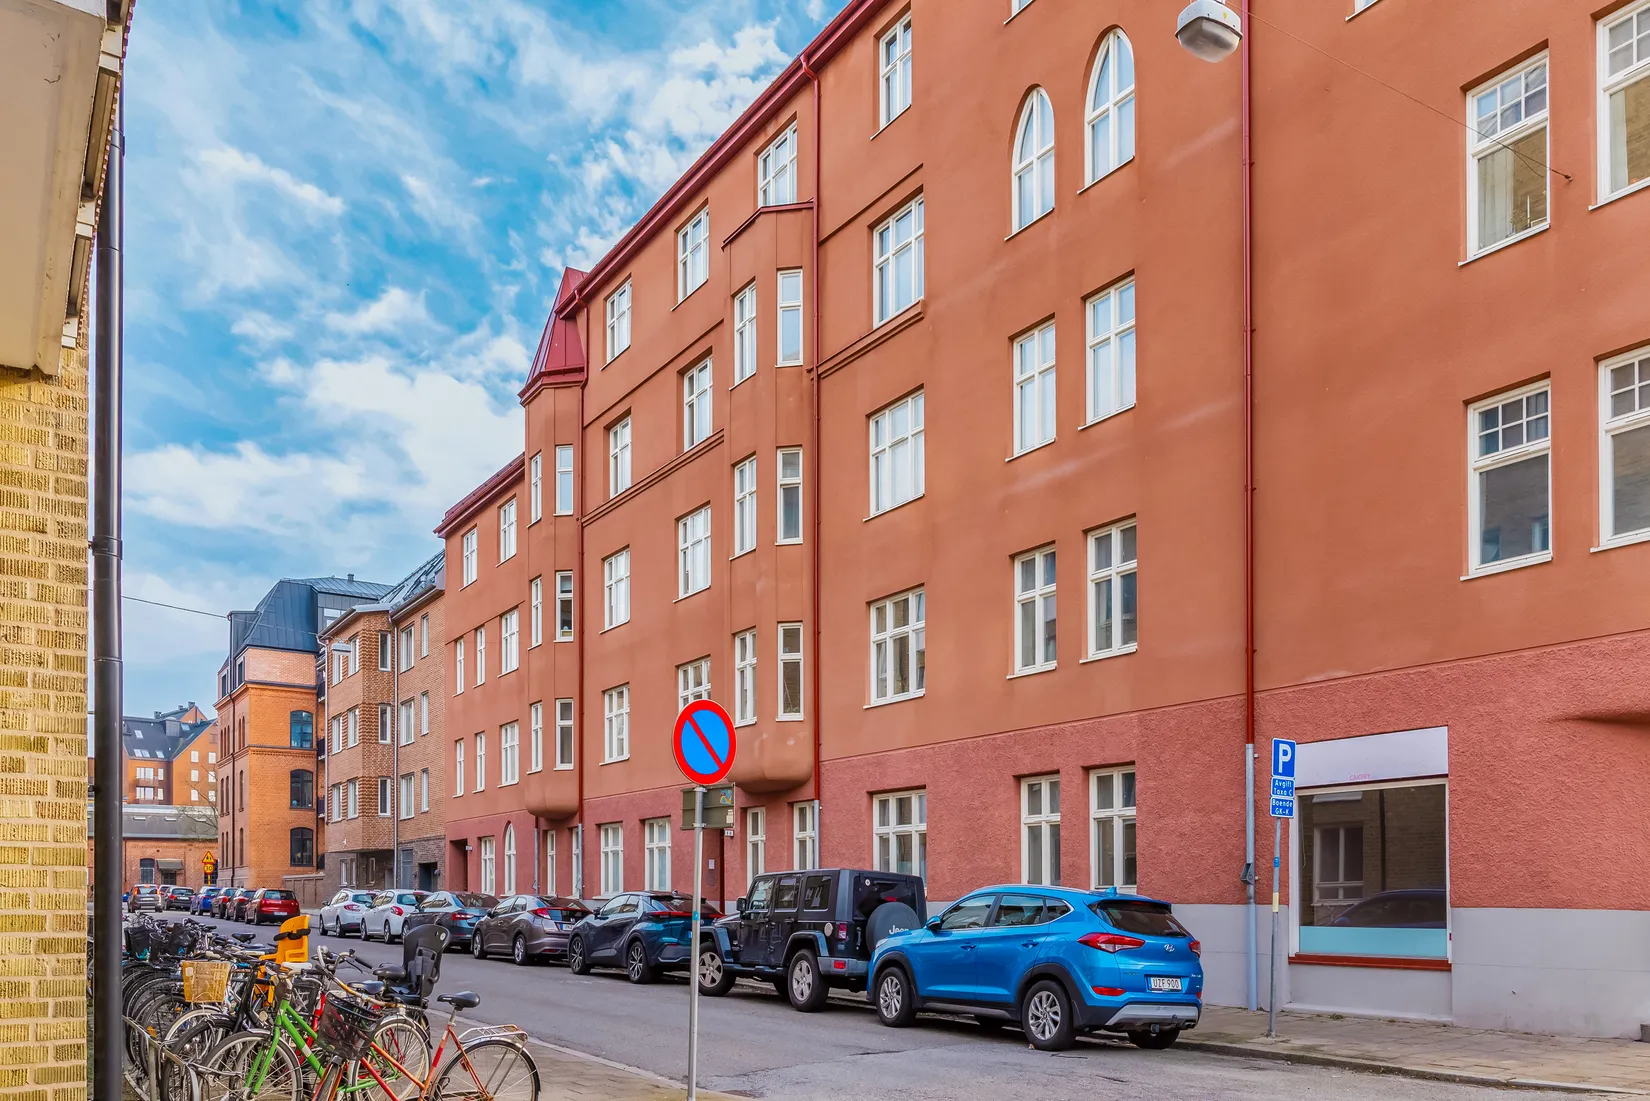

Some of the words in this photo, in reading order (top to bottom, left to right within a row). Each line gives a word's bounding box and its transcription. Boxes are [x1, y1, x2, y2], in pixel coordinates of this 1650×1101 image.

[1278, 743, 1292, 773] P
[1274, 779, 1292, 789] Avgift
[1273, 787, 1287, 796] Taxa
[1272, 798, 1293, 808] Boende
[1166, 979, 1180, 988] 900
